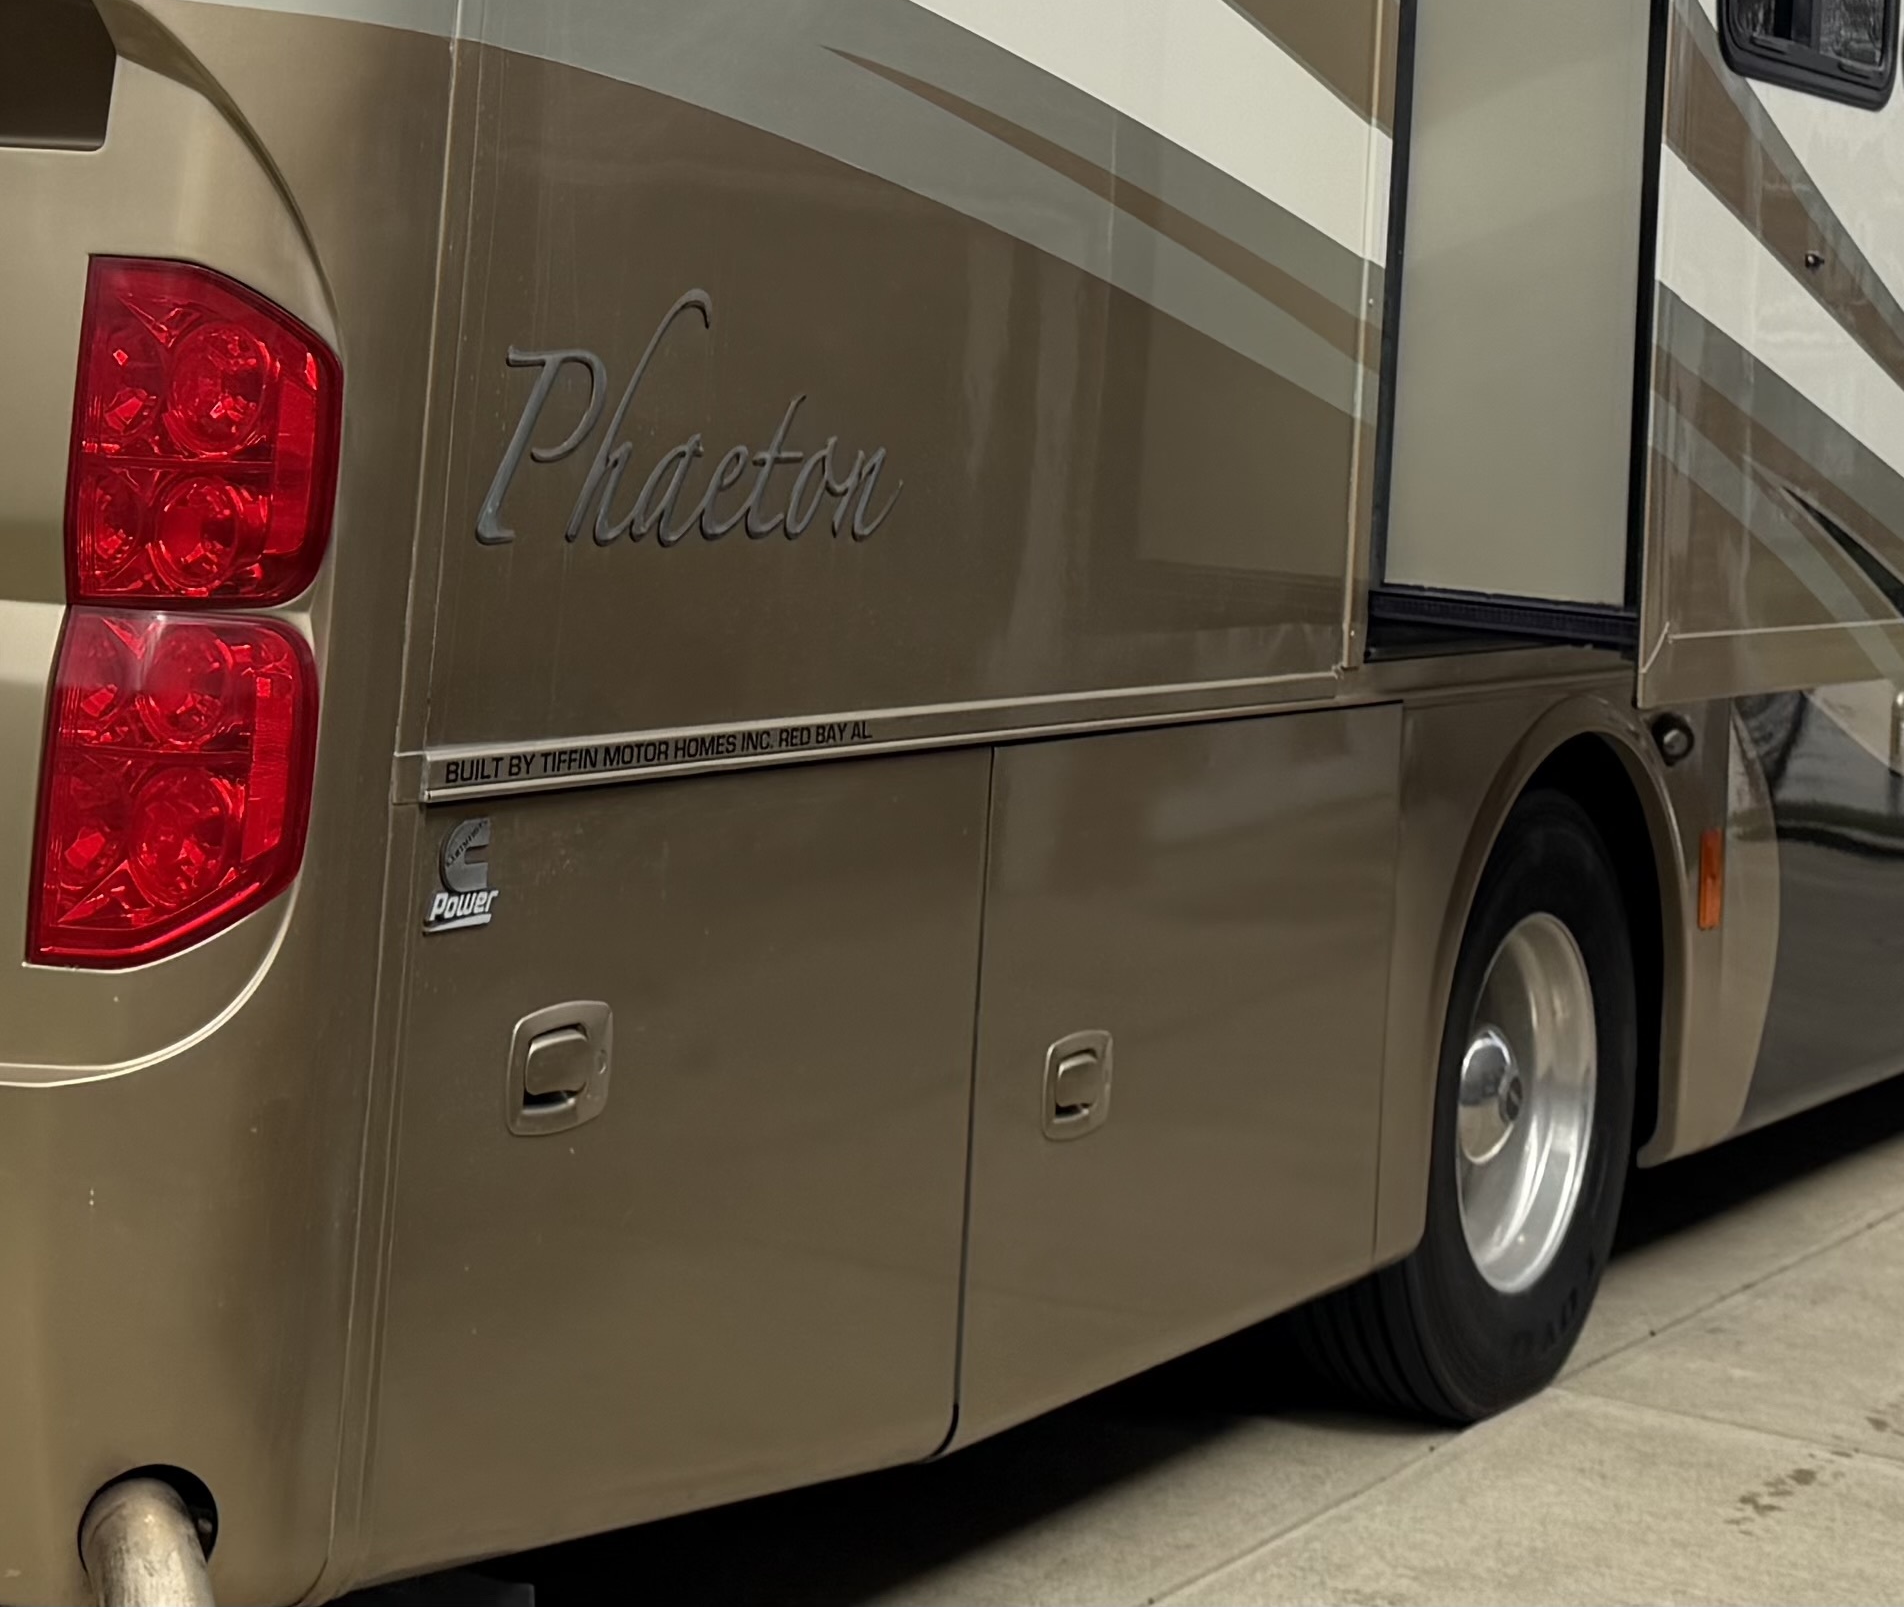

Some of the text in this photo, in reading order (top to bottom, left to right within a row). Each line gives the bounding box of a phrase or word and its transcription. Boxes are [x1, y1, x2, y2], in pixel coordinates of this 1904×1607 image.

[475, 287, 904, 548] Phaeton
[445, 720, 873, 784] BUILT BY TIFFIN MOTOR HOMES INC. RED BAY AL
[429, 889, 499, 922] Power
